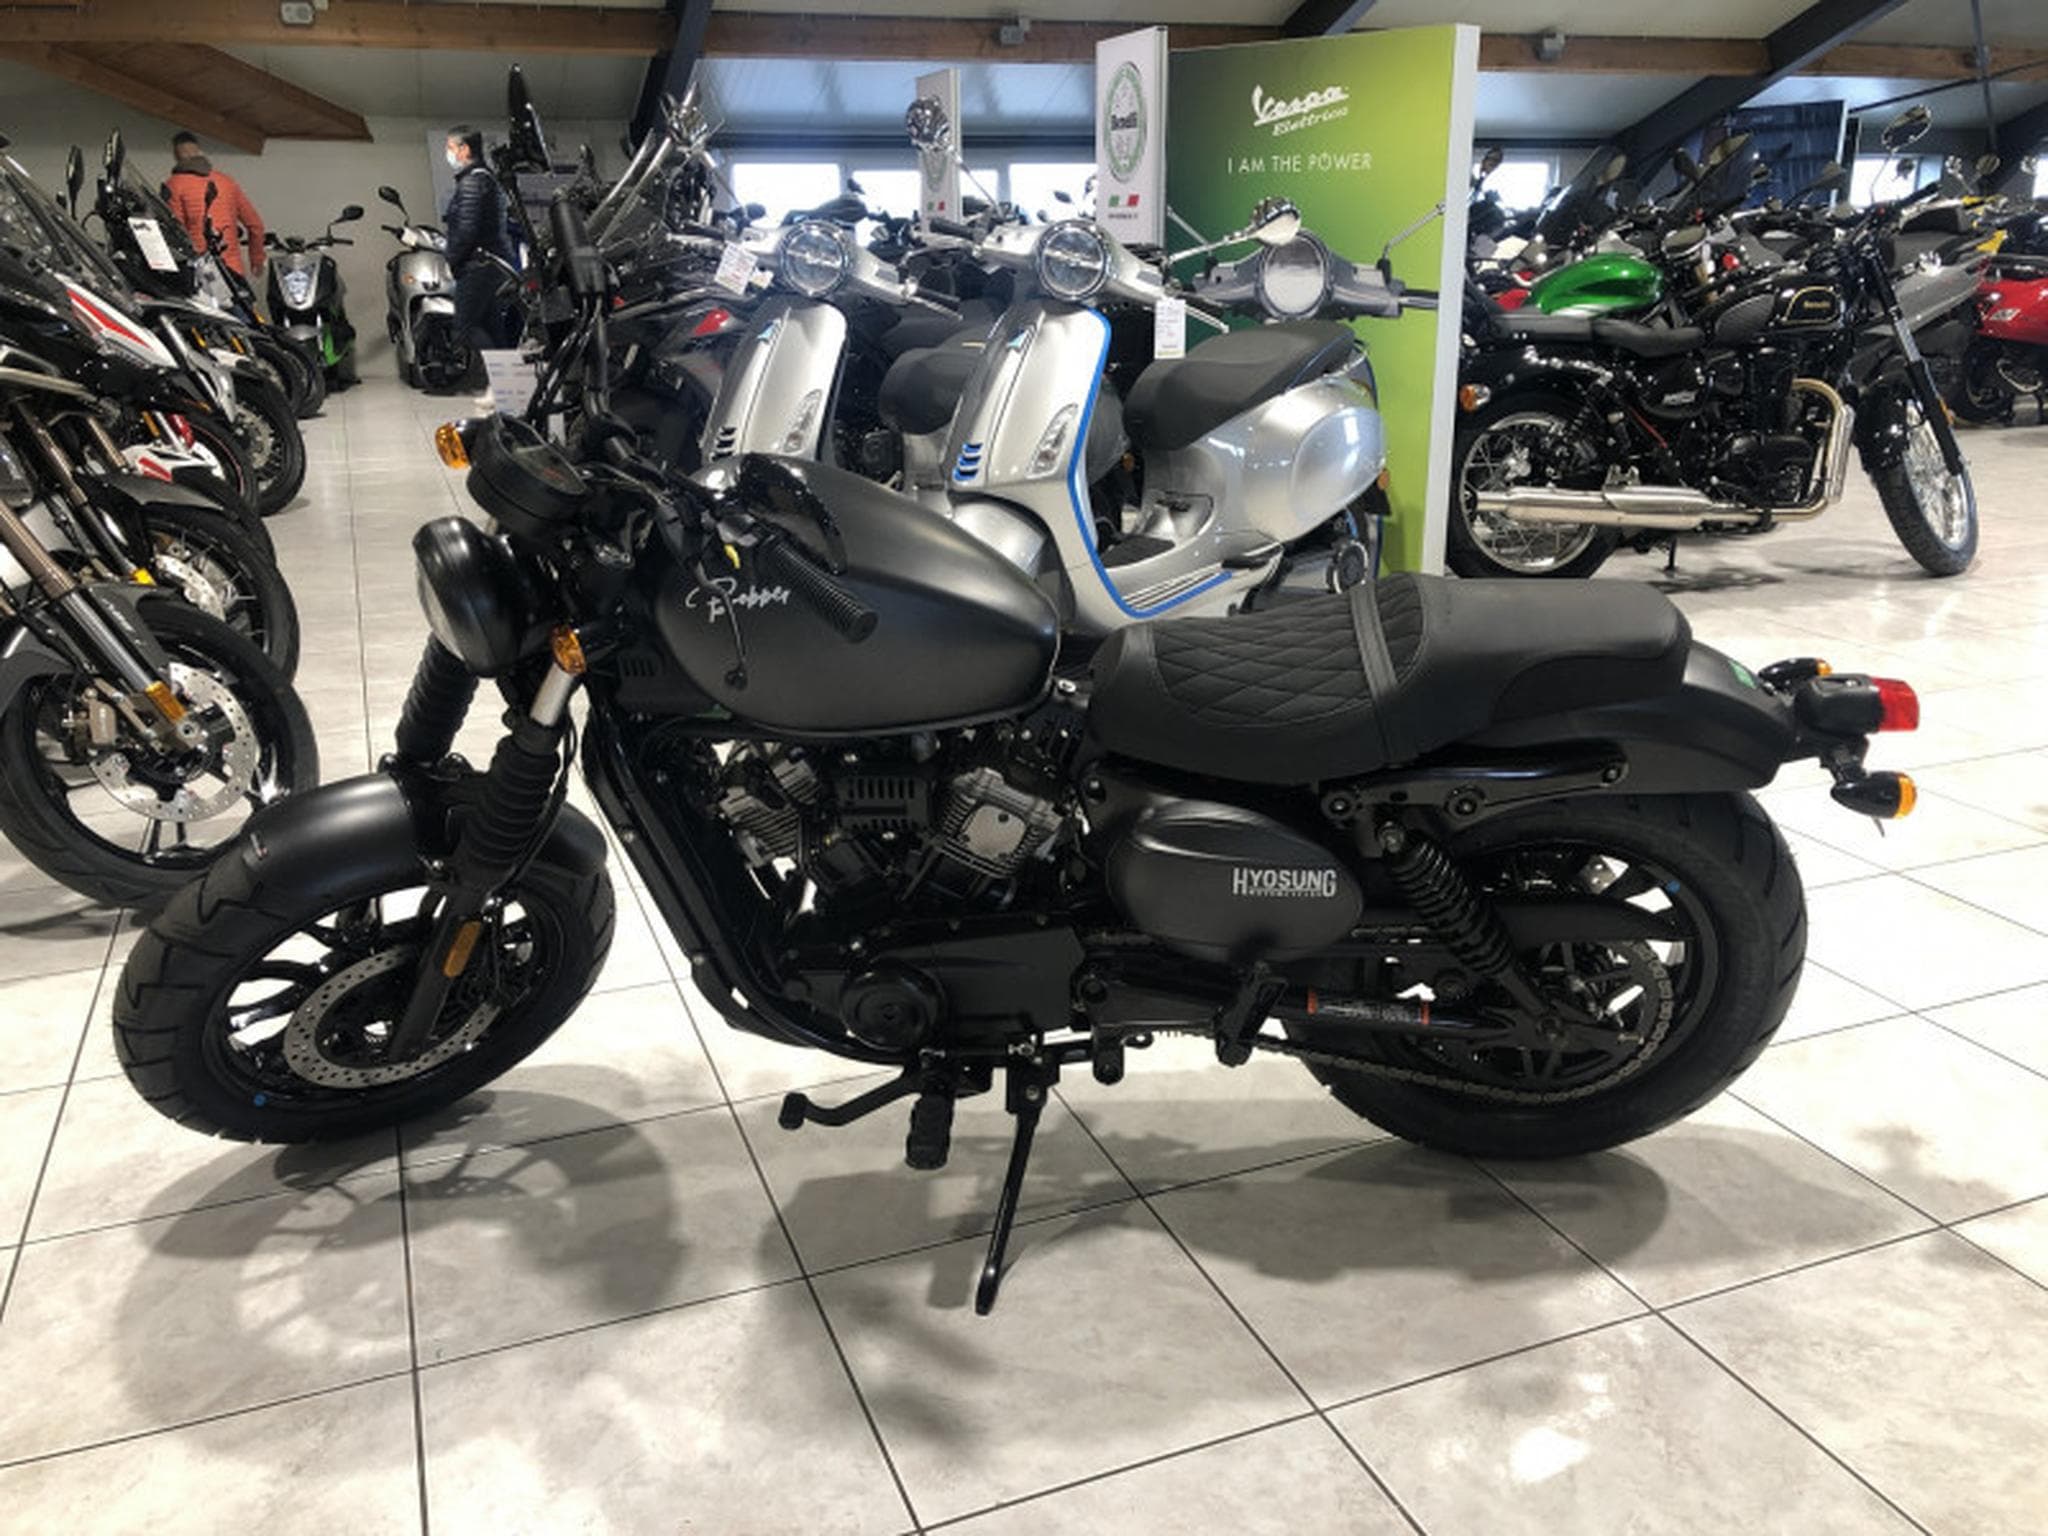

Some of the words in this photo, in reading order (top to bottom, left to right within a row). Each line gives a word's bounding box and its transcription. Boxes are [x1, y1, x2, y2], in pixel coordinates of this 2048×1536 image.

[1252, 84, 1349, 127] Vespa
[1227, 157, 1233, 174] I
[1238, 157, 1265, 173] AM
[1272, 154, 1301, 172] THE
[1308, 152, 1373, 171] POWER
[1233, 867, 1337, 897] HYOSUNG
